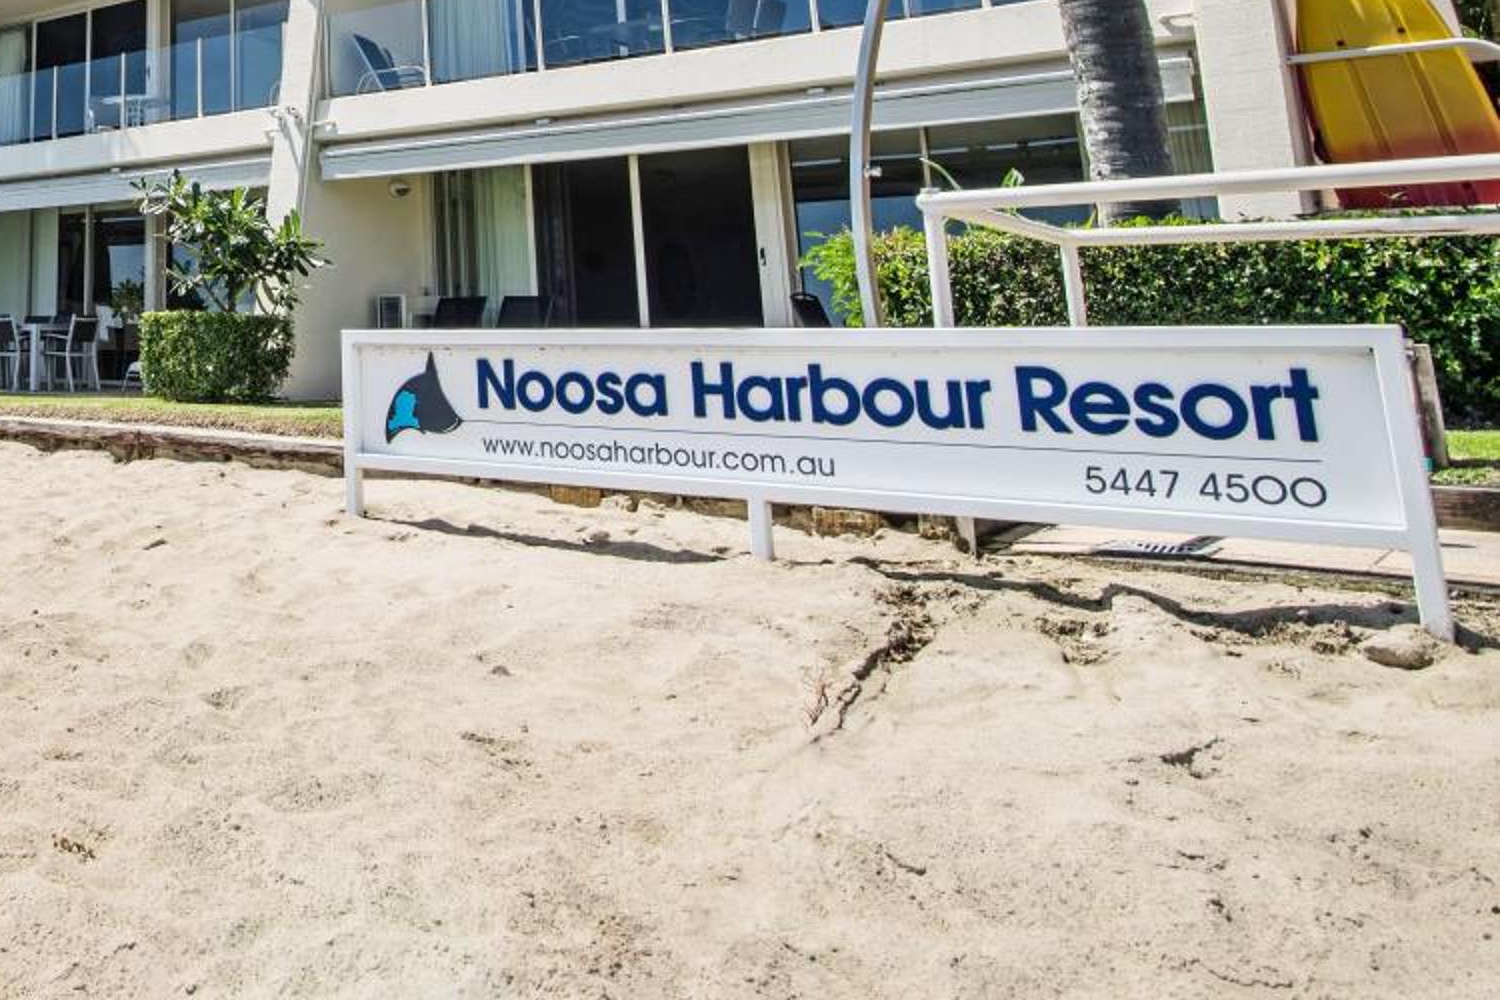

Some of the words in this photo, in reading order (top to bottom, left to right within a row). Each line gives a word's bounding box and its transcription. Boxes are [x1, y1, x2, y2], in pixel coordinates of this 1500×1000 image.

[474, 356, 669, 419] Noosa
[689, 360, 992, 431] Harbour
[1014, 365, 1322, 443] Resort
[483, 437, 836, 478] www.noosaharbour.com.au
[1085, 465, 1180, 499] 5447
[1199, 471, 1329, 509] 4500
